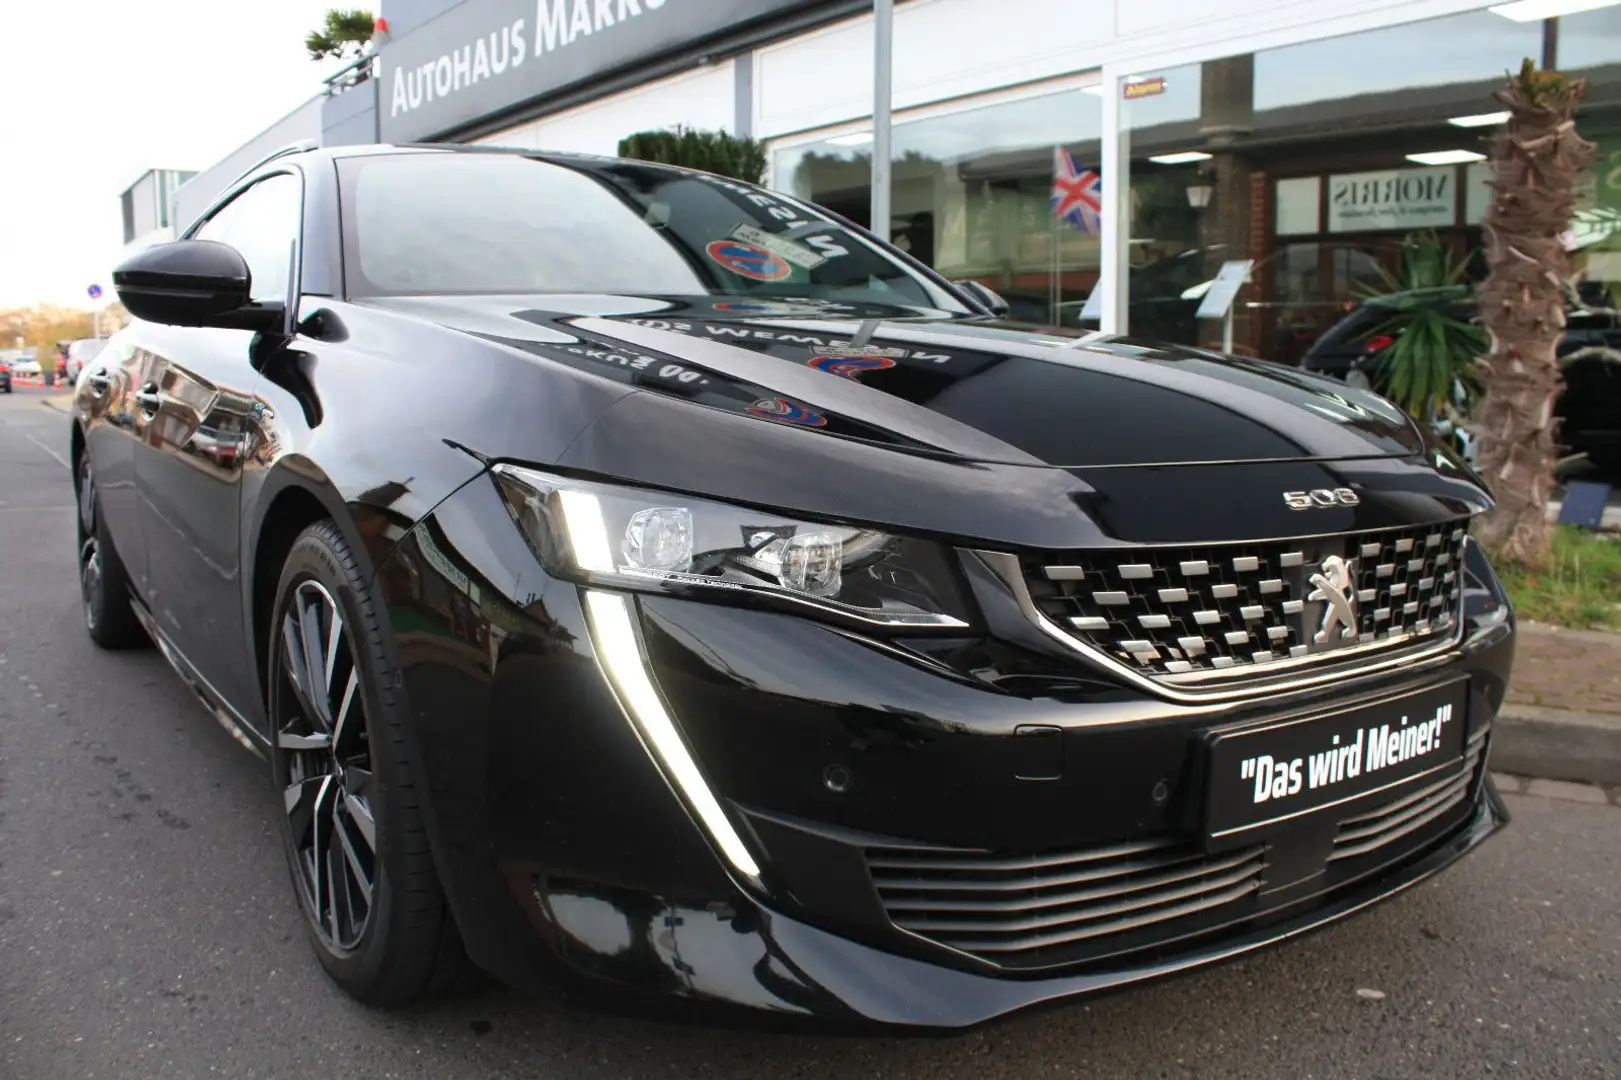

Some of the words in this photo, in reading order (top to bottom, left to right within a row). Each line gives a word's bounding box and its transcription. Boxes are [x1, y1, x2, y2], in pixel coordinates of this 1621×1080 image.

[391, 18, 526, 117] AUTOHAUS
[1282, 487, 1361, 511] 508
[1240, 754, 1304, 804] "Das
[1307, 728, 1364, 790] wird
[1365, 703, 1454, 773] Meiner!"
